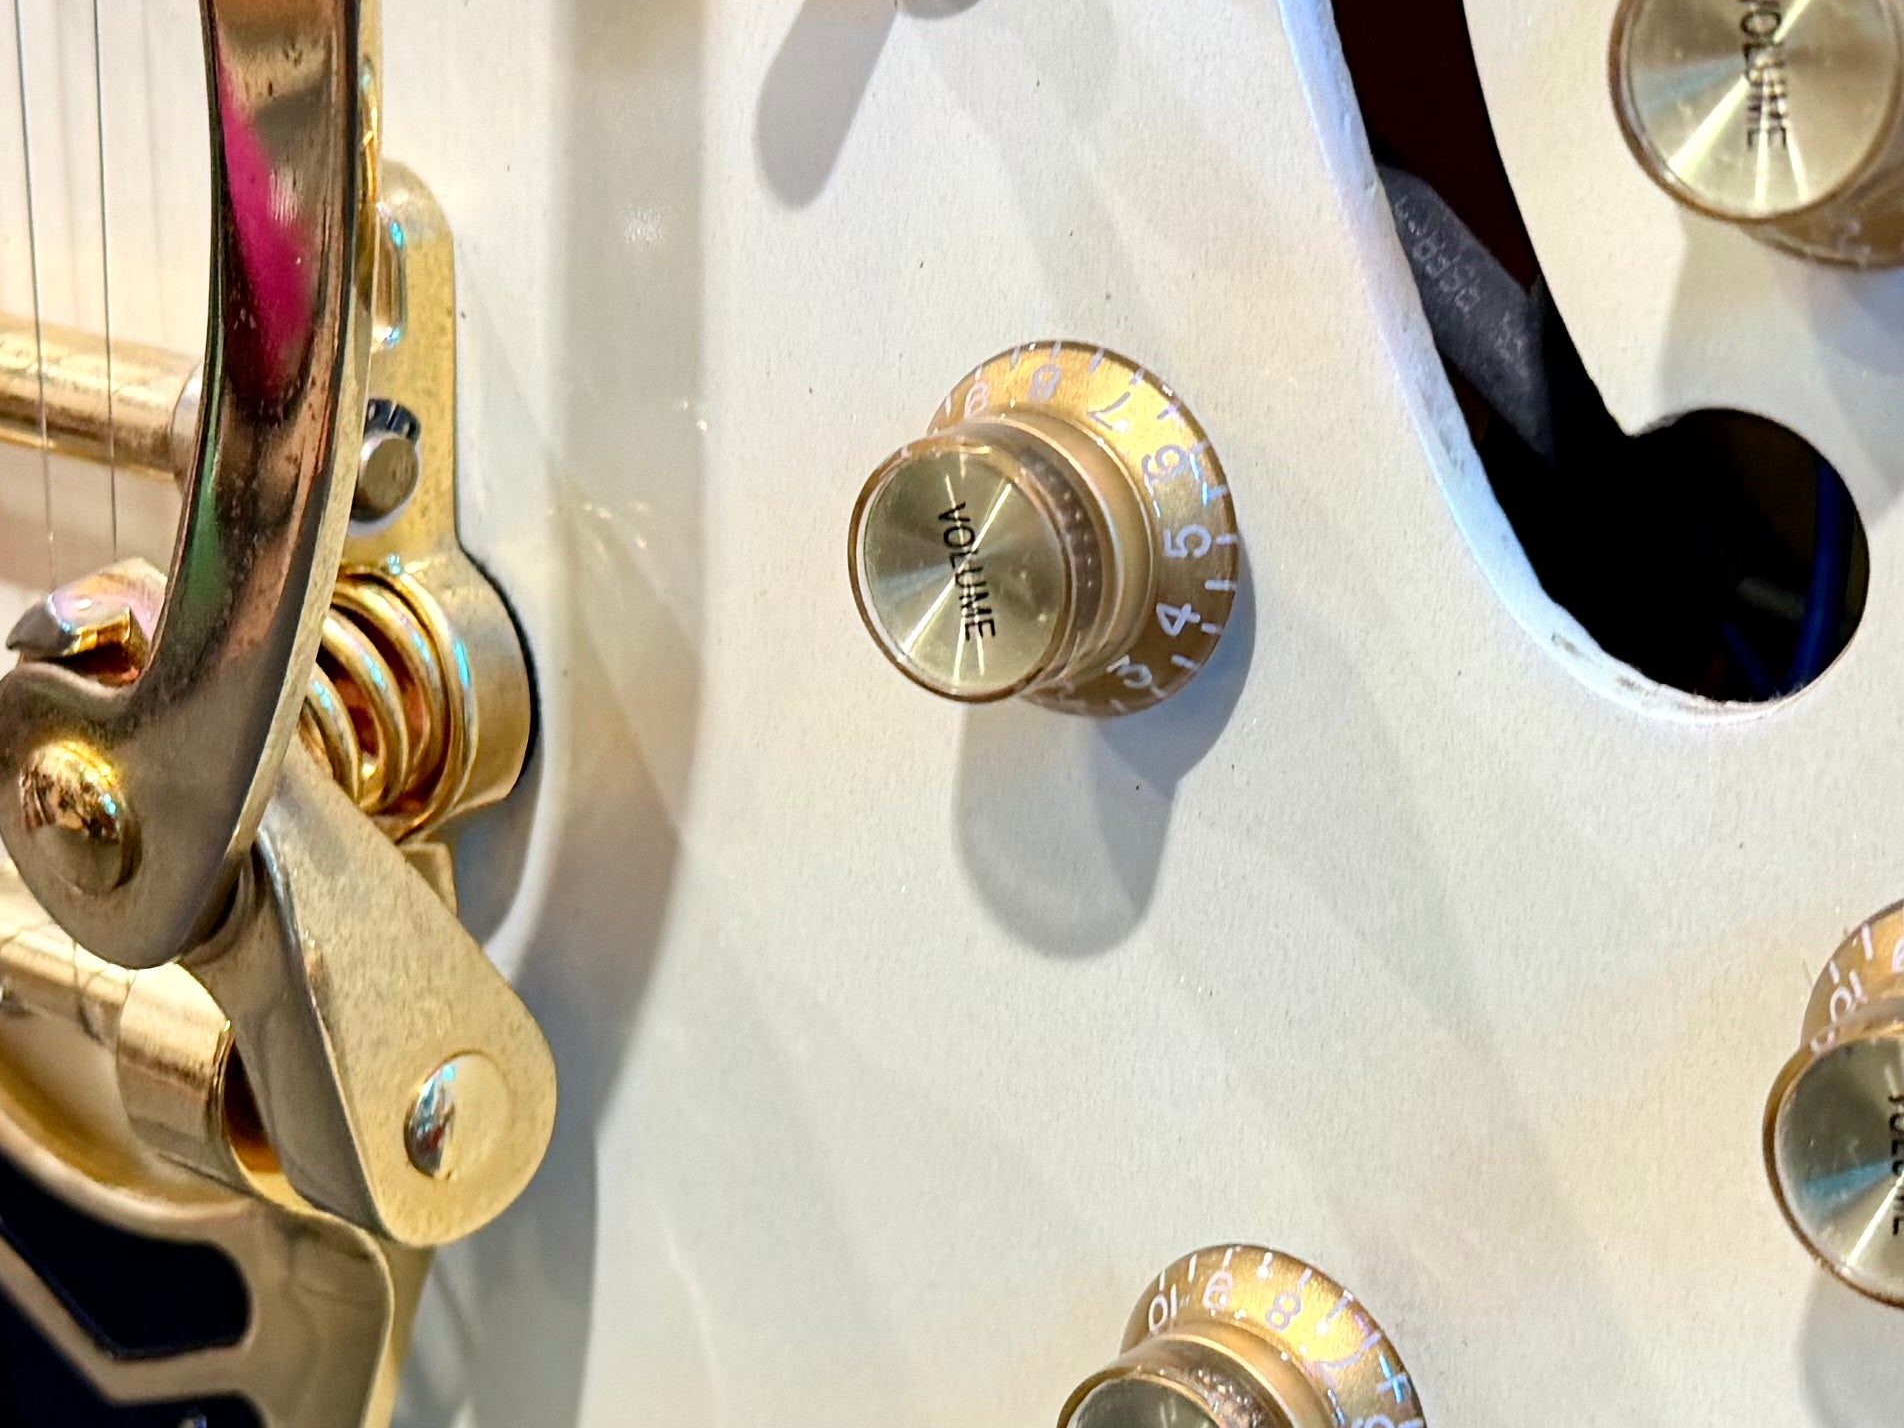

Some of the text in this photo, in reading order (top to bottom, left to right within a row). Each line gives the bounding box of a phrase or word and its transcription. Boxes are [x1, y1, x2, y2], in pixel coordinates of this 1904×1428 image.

[1087, 391, 1131, 431] 7
[1142, 444, 1187, 483] 6
[1162, 523, 1212, 559] 5
[937, 501, 996, 643] VOLUME
[1155, 602, 1201, 637] 4
[1105, 654, 1153, 689] 3
[1149, 1283, 1178, 1334] 10
[1266, 1291, 1302, 1331] 8
